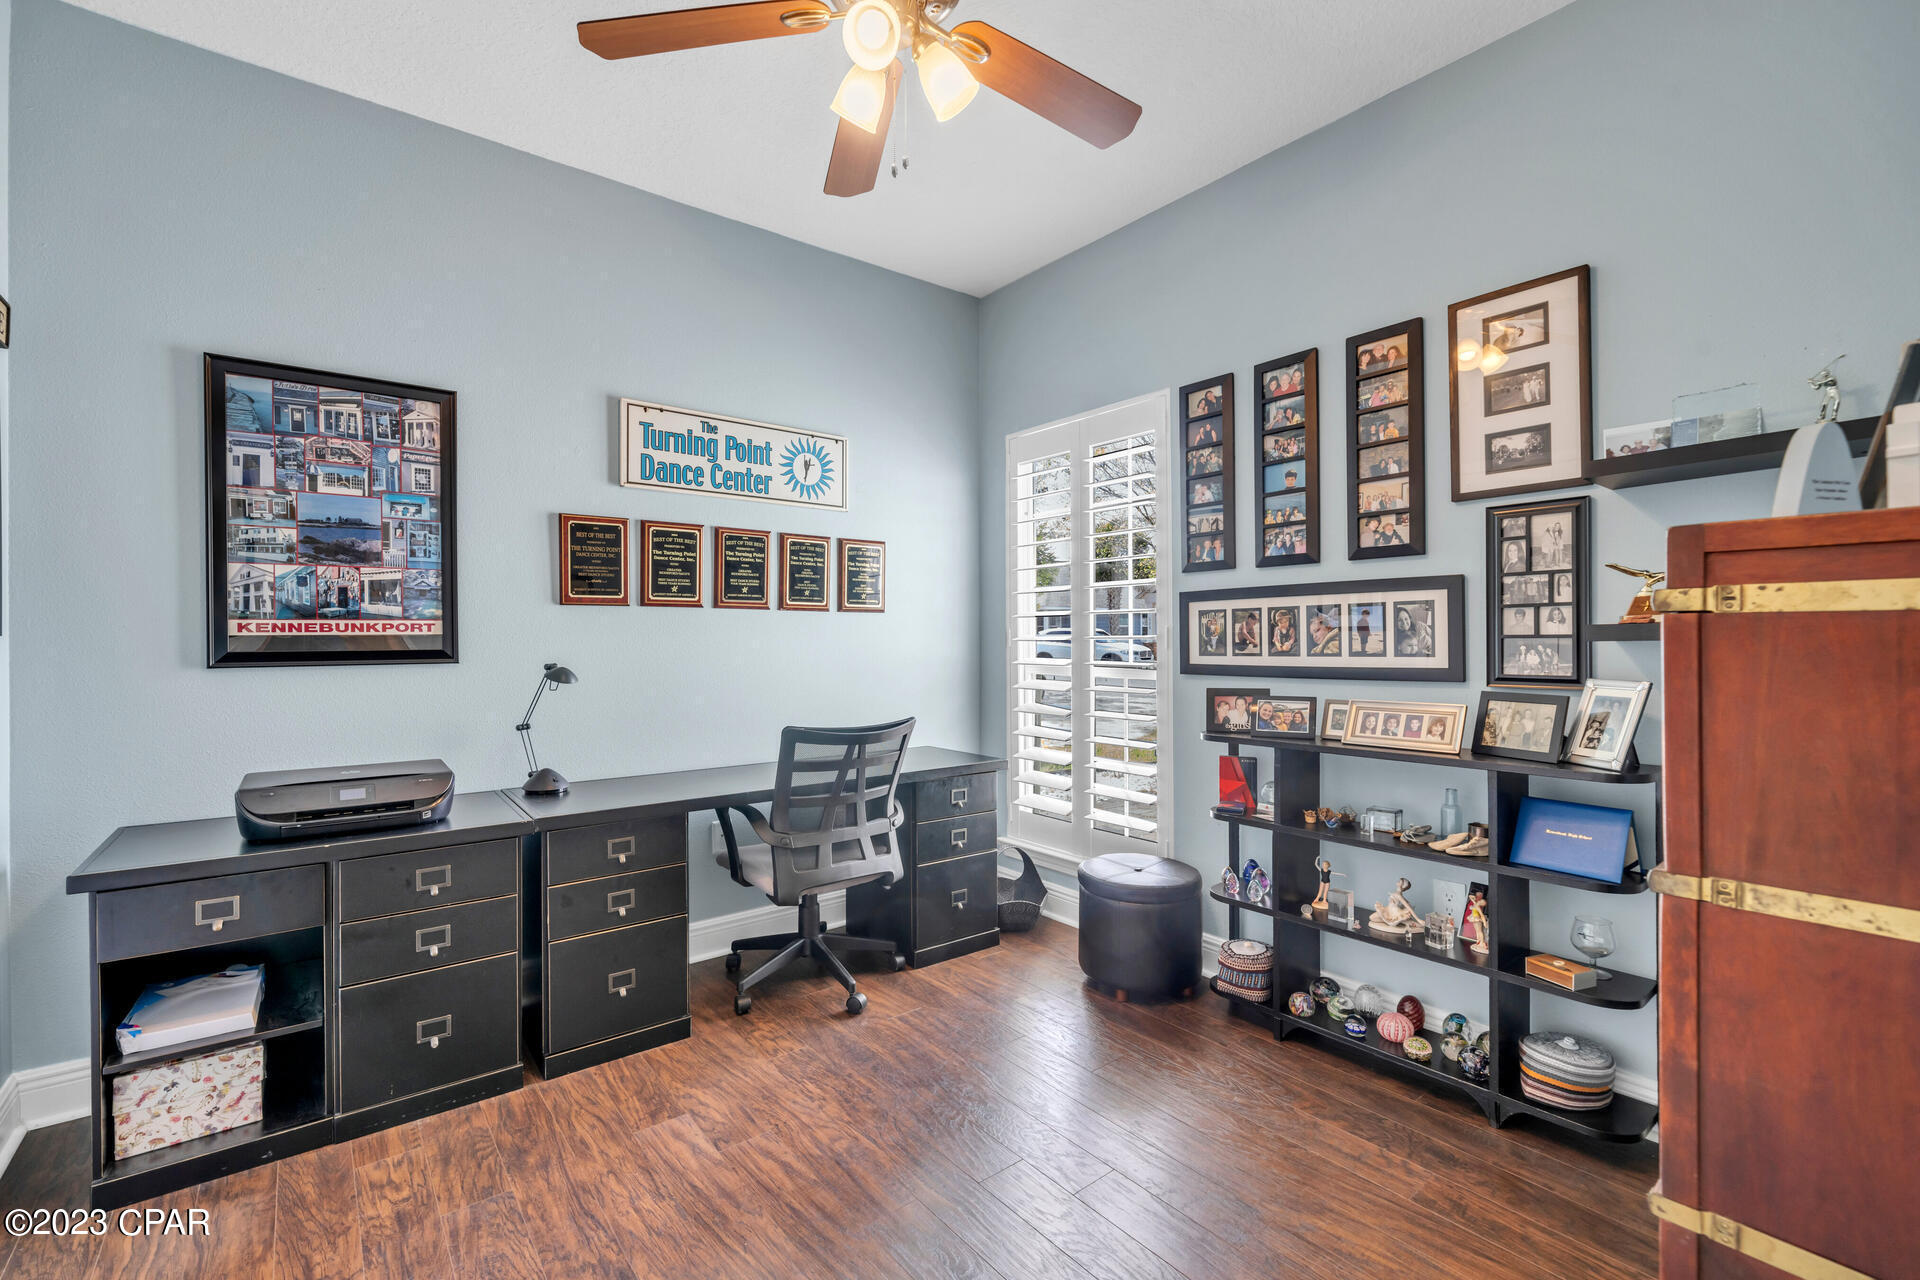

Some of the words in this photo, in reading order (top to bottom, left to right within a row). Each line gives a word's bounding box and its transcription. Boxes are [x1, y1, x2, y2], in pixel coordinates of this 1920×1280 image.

[700, 420, 718, 434] The
[639, 421, 718, 464] Turning
[725, 435, 772, 466] Point
[640, 452, 704, 486] Dance
[710, 462, 773, 494] Center
[237, 622, 435, 633] KENNEBUNKPORT
